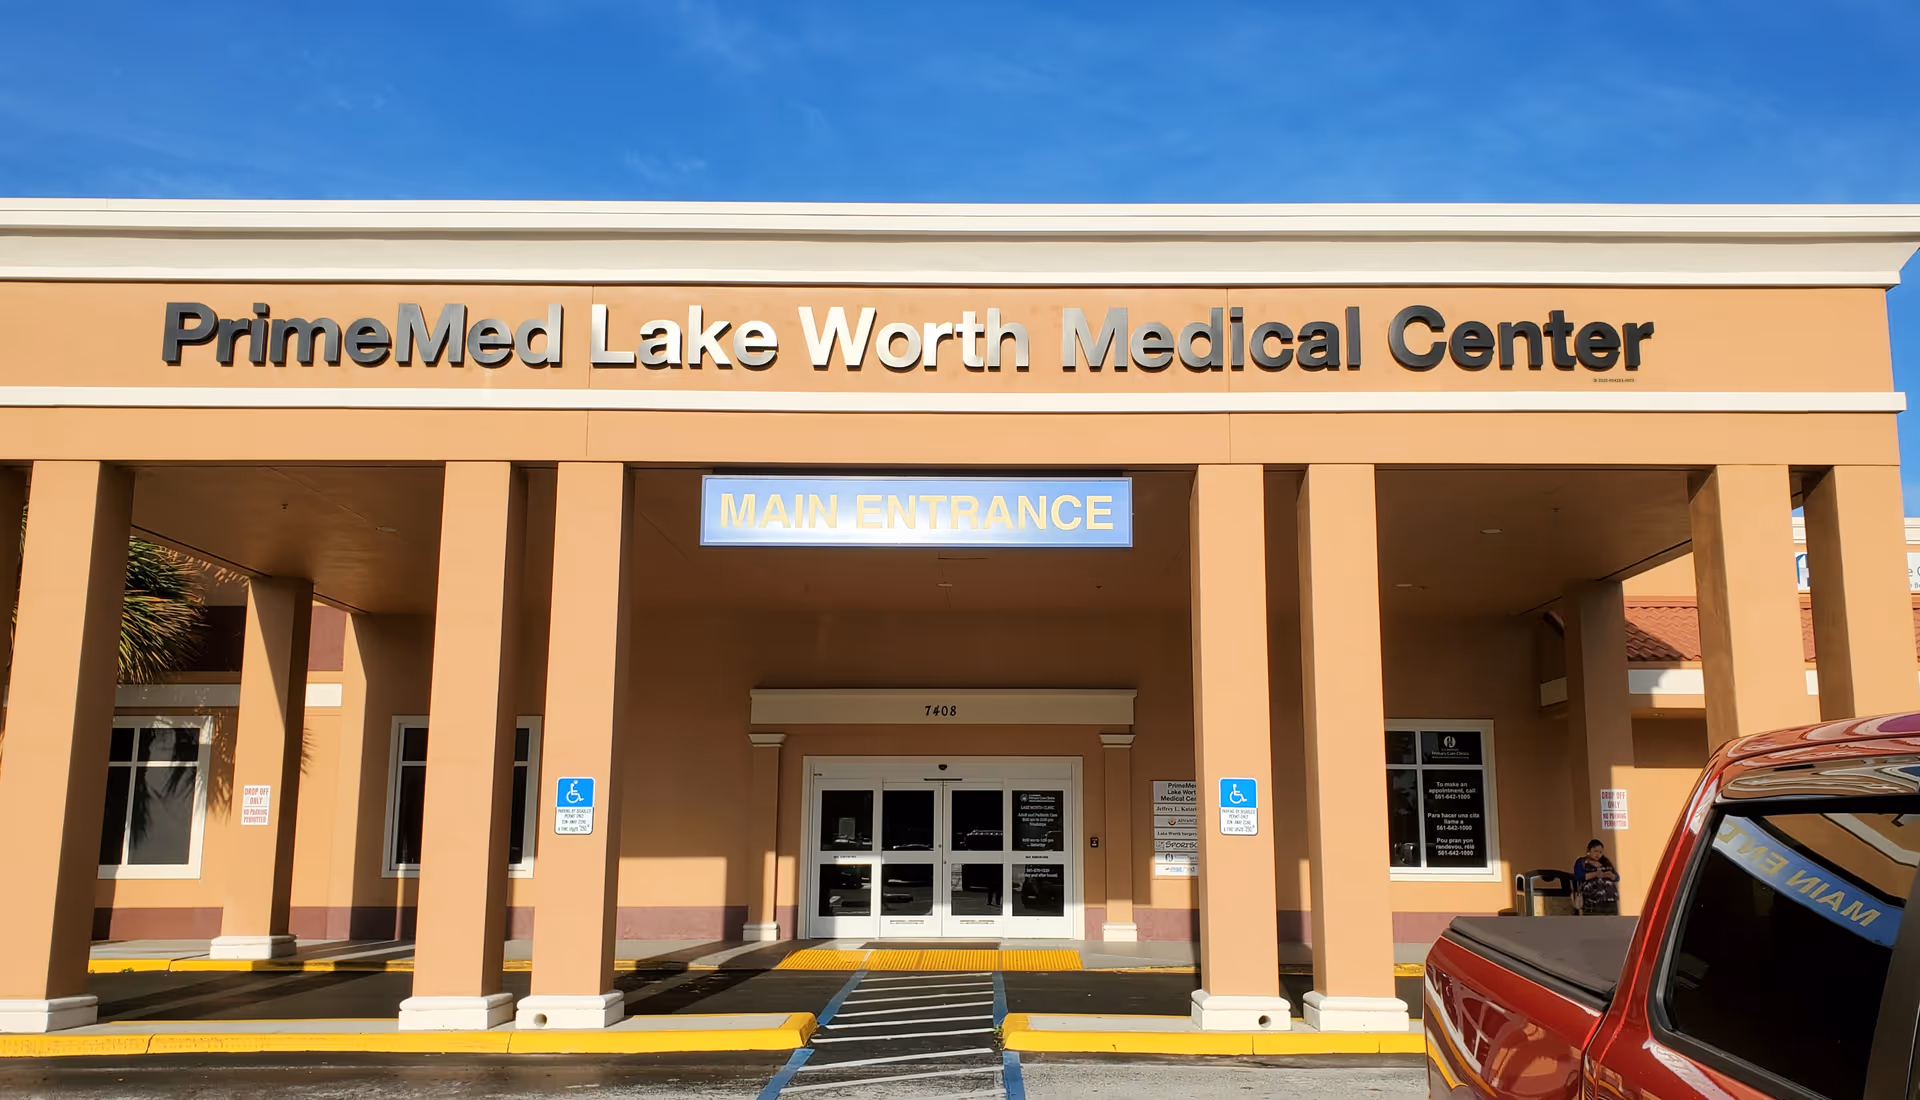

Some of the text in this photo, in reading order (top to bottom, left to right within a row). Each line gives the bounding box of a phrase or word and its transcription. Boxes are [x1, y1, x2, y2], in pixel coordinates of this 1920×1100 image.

[162, 302, 1655, 372] PrimeMed Lake Worth Medical Center
[720, 493, 1115, 531] MAIN ENTRANCE
[924, 704, 957, 717] 7408
